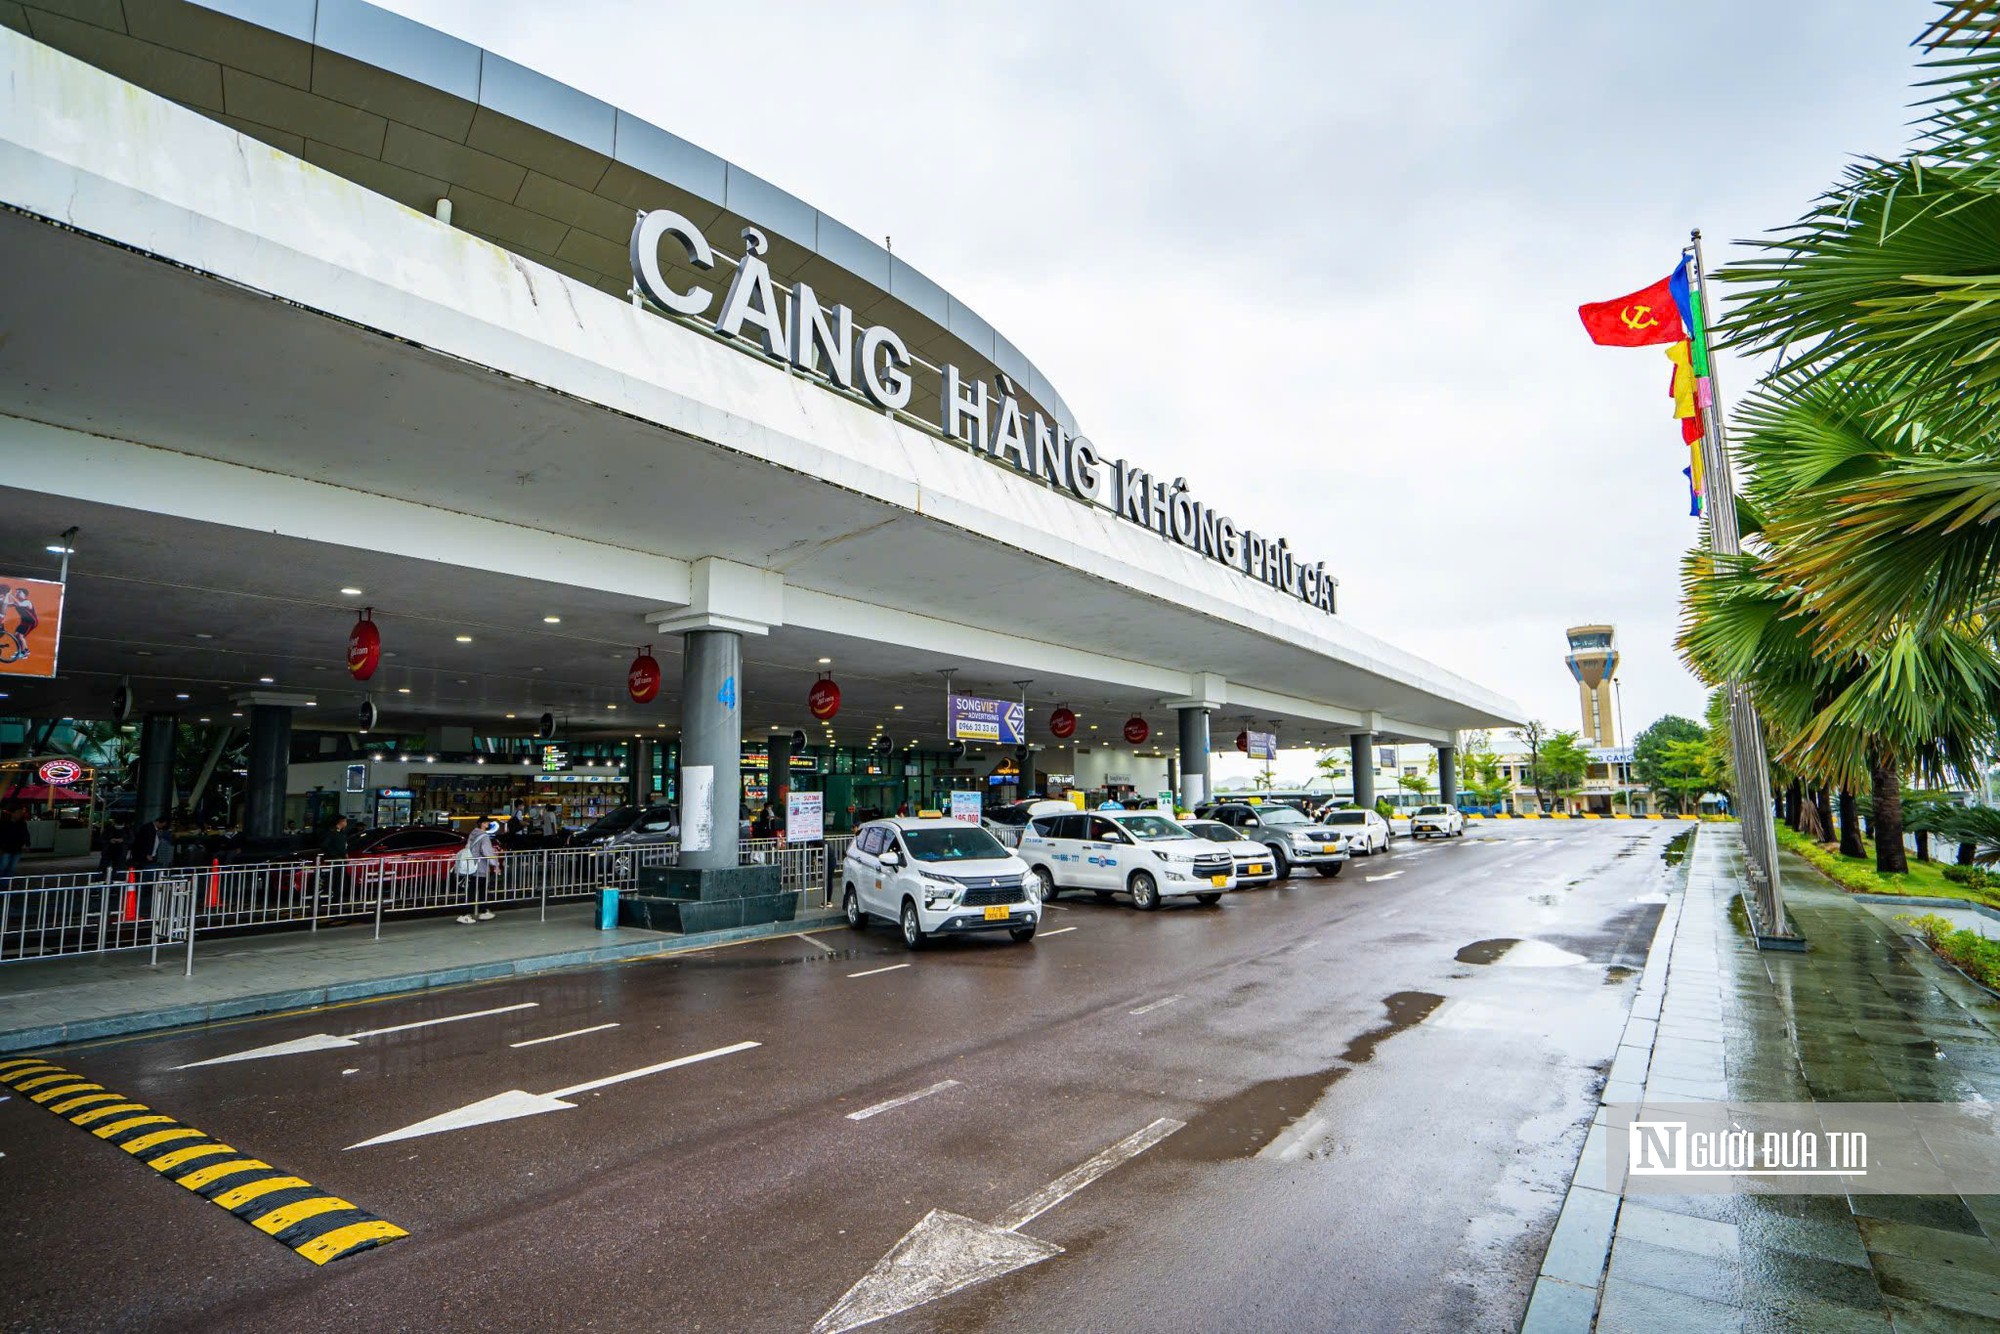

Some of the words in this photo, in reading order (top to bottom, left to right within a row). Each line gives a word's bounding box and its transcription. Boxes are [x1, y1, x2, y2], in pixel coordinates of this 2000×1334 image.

[630, 208, 912, 411] CẢNG
[942, 363, 1100, 500] HÀNG
[1116, 459, 1238, 566] KHÔNG
[1300, 562, 1340, 614] CÁT
[718, 674, 735, 711] 4
[956, 698, 999, 713] SONGVIET
[968, 712, 999, 721] ADVERTISING
[959, 722, 973, 731] 0966
[975, 723, 981, 731] 33
[983, 723, 990, 732] 33
[991, 724, 998, 733] 60
